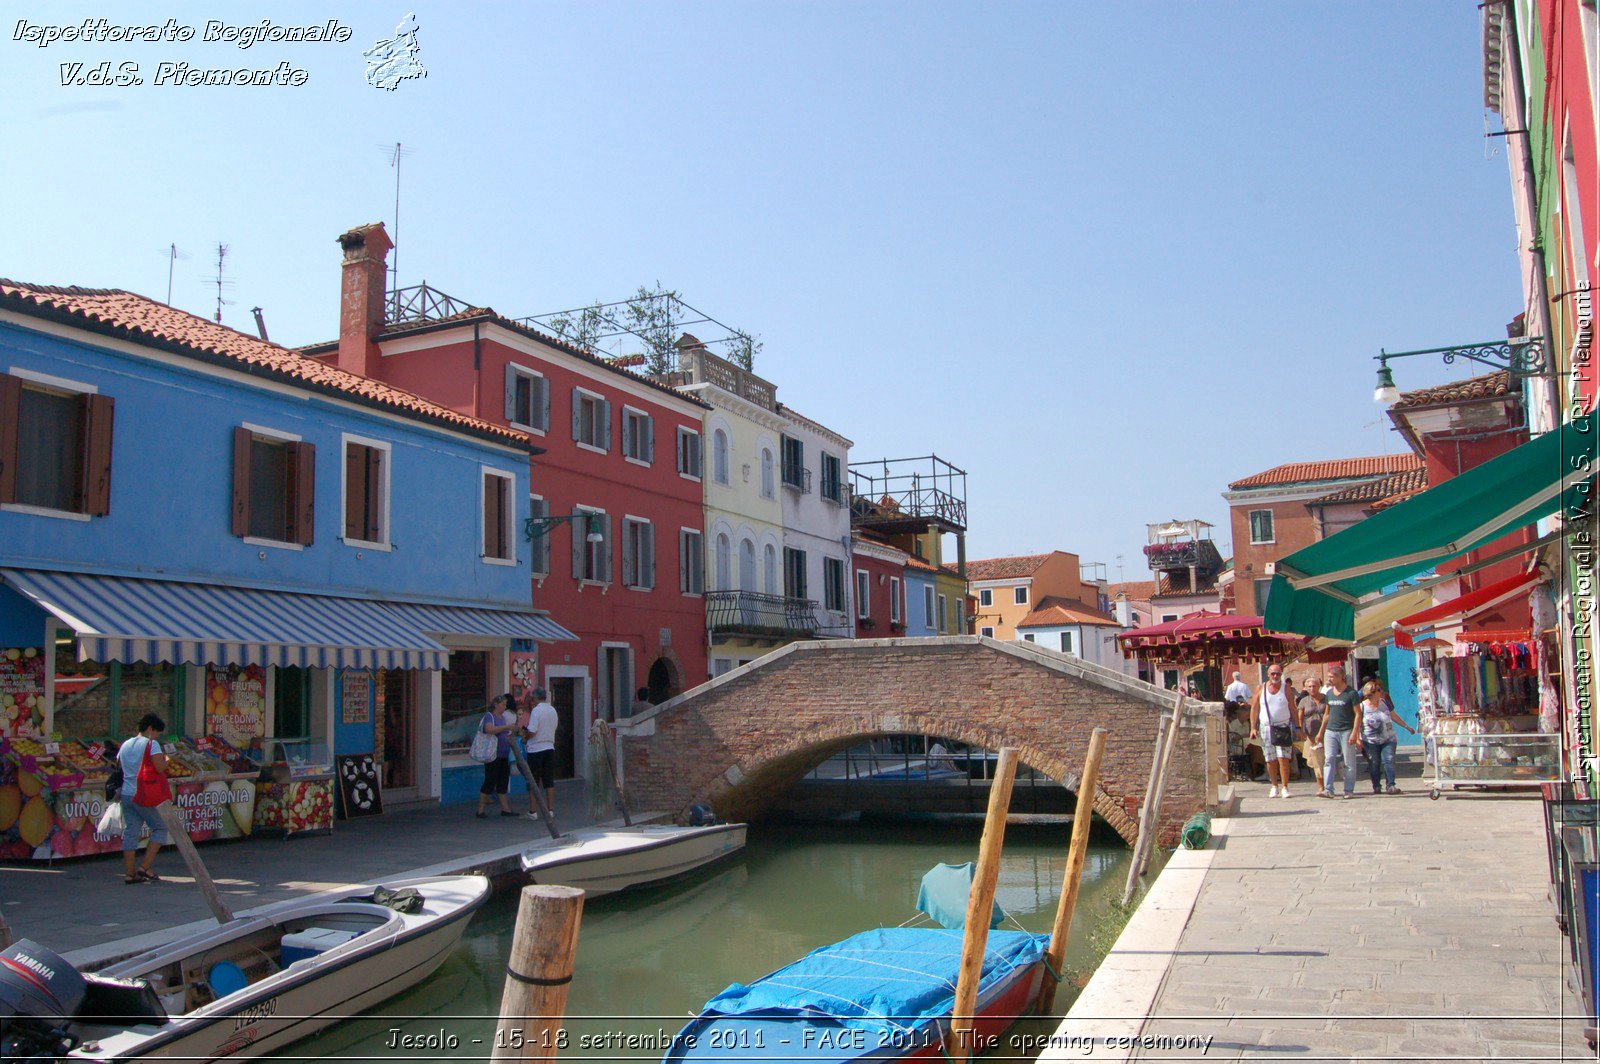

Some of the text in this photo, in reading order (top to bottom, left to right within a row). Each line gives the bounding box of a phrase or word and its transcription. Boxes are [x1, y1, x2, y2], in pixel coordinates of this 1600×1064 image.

[212, 714, 259, 724] MACEDONIA
[177, 788, 250, 808] MACEDONIA
[65, 802, 100, 818] VINO
[195, 807, 224, 819] SALAD
[198, 819, 224, 831] FRAIS
[13, 952, 56, 981] YAMAHA
